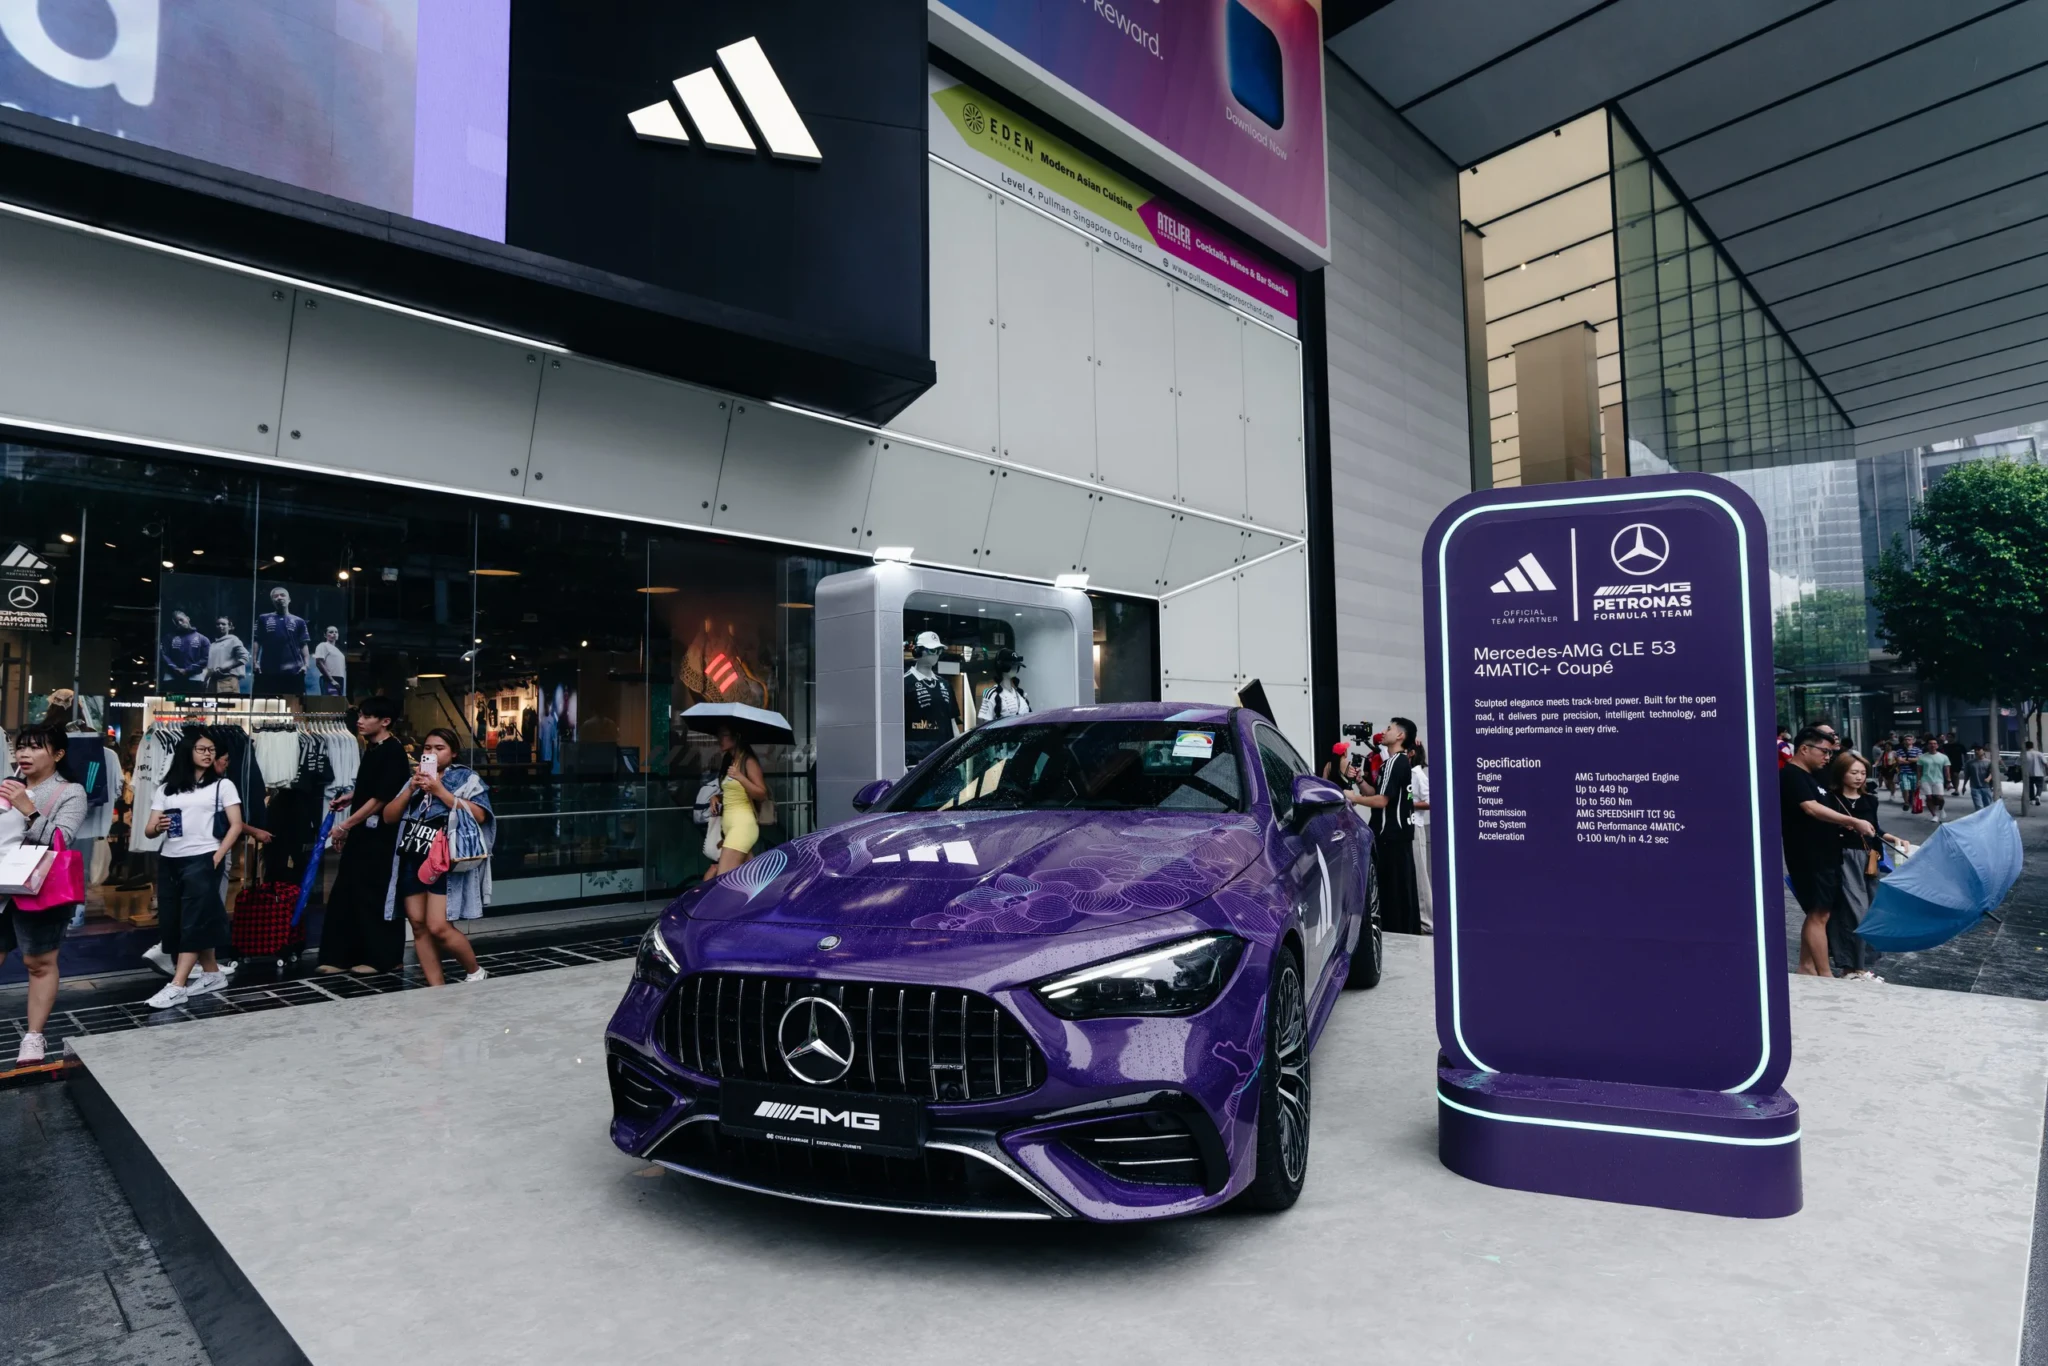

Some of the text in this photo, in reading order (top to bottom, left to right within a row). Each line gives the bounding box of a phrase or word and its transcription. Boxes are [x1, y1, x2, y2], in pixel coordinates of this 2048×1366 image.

[990, 117, 1034, 155] EDEN
[1226, 106, 1288, 161] Download Now
[1040, 152, 1133, 212] Modern Asian Cuisine
[1001, 172, 1143, 253] Level 4, Pullman Singapore Orchard
[1157, 211, 1191, 246] ATELIER
[1195, 238, 1289, 297] Cocktails, Wines & Bar Snacks
[1172, 263, 1275, 321] www.pullmansingaporeorchard.com
[1594, 595, 1691, 611] PETRONAS
[1503, 609, 1545, 617] OFFICIAL
[1594, 609, 1692, 620] FORMULA 1 TEAM
[1475, 641, 1676, 661] Mercedes-AMG CLE 53
[1474, 660, 1613, 677] 4MATIC+ Coupé
[1475, 694, 1716, 709] Sculpted elegance meets track-bred power. Built for the open
[1476, 708, 1716, 722] road, it delivers pure precision, intelligent technology, and
[1476, 725, 1618, 736] unyielding performance in every drive.
[1477, 757, 1541, 770] Specification
[1477, 772, 1501, 782] Engine
[1575, 772, 1679, 784] AMG Turbocharged Engine
[1478, 784, 1499, 793] Power
[1576, 785, 1628, 795] Up to 449 hp
[1478, 795, 1503, 806] Torque
[1576, 797, 1632, 807] Up to 560 Nm
[1478, 807, 1526, 817] Transmission
[1577, 809, 1675, 819] AMG SPEEDSHIFT TCT 9G
[1479, 819, 1526, 830] Drive System
[1577, 821, 1685, 832] AMG Performance 4MATIC+
[1479, 832, 1524, 840] Acceleration
[1577, 833, 1668, 844] 0-100 km/h in 4.2 sec
[790, 1136, 809, 1144] CARRIAGE
[816, 1140, 862, 1150] EXCEPTIONAL JOURNEYS
